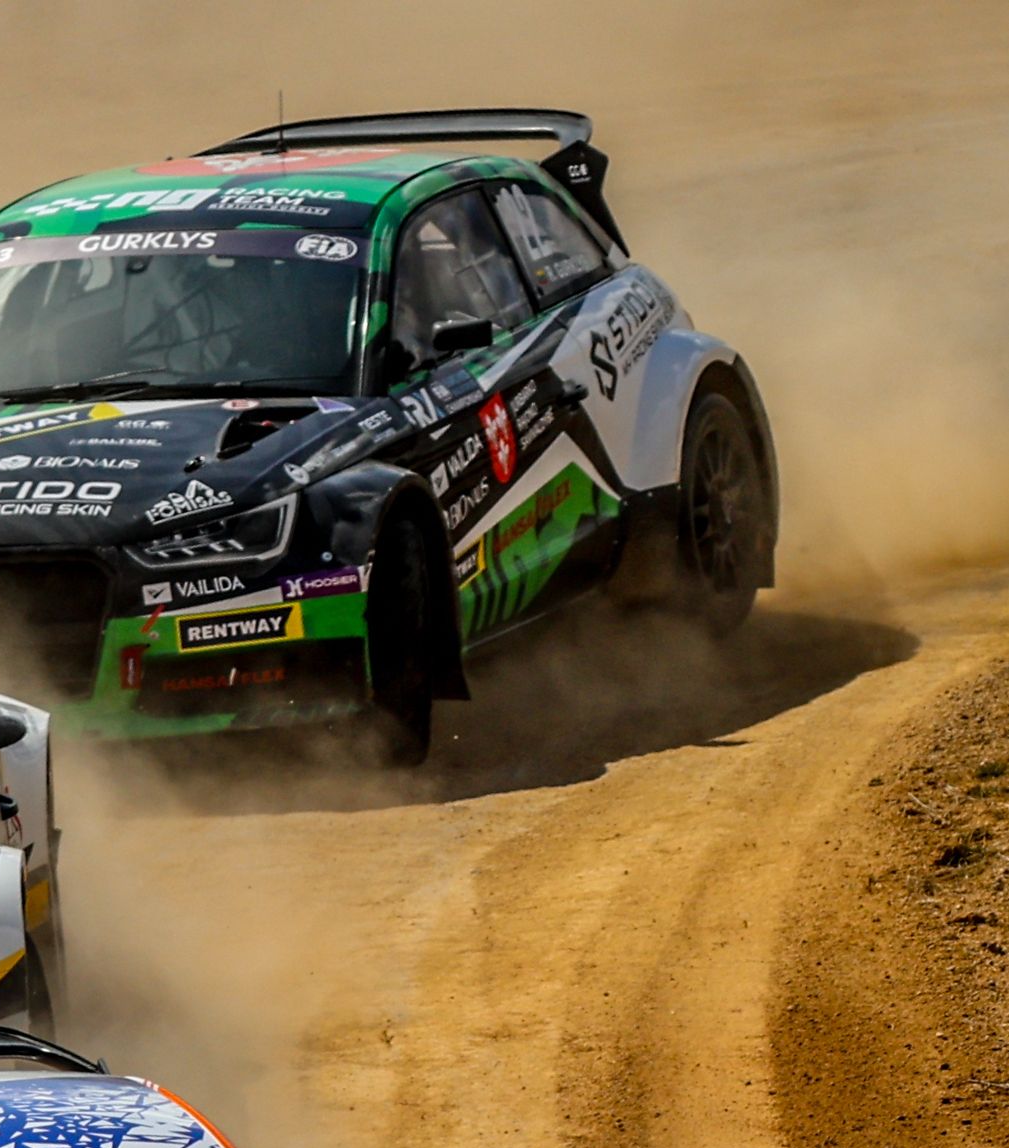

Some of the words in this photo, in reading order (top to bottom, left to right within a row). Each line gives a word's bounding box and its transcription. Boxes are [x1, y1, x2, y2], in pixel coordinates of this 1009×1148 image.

[219, 196, 306, 206] TEAM
[223, 188, 346, 200] RACING
[78, 231, 218, 253] GURKLYS
[300, 236, 351, 258] FIA
[57, 503, 113, 517] SKIN
[175, 575, 246, 598] VAILIDA
[304, 574, 358, 590] HOOSIER
[187, 615, 283, 643] RENTWAY
